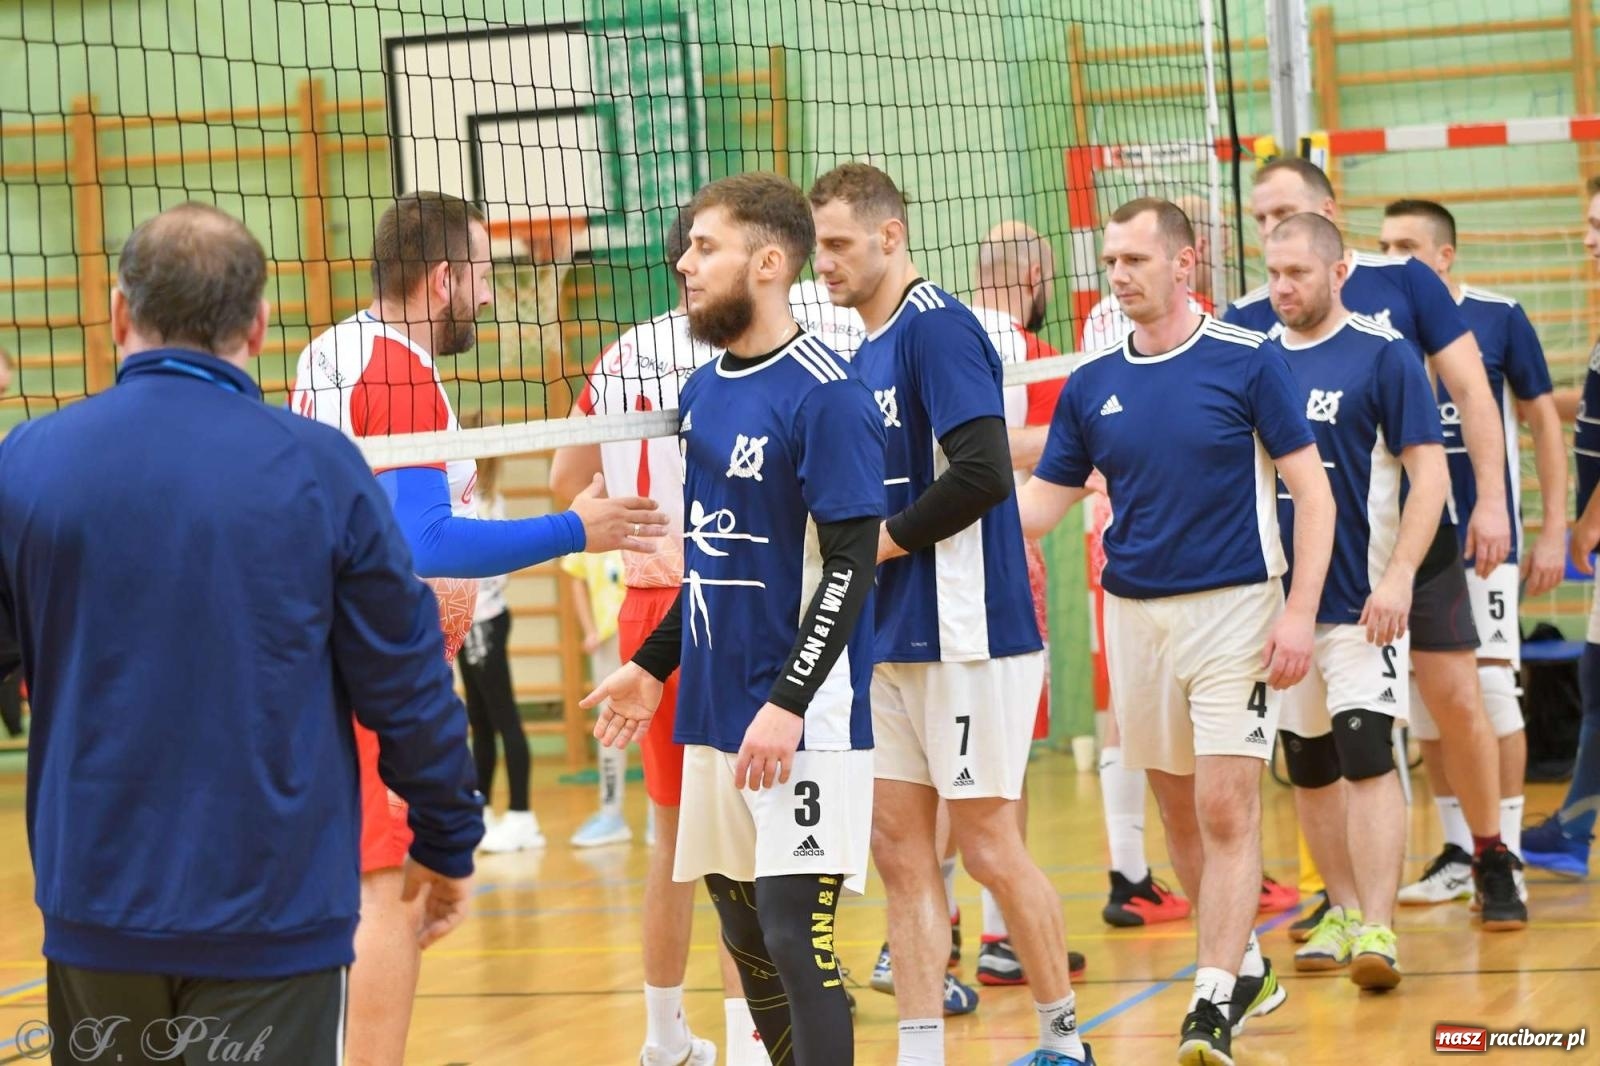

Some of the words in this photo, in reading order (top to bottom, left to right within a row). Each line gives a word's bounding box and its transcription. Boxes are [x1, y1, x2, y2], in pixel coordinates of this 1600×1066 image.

[819, 568, 853, 613] WILL
[1488, 590, 1505, 620] 5
[814, 623, 830, 639] &
[815, 614, 836, 627] I
[793, 635, 826, 677] CAN
[786, 674, 805, 686] I
[1247, 681, 1268, 719] 4
[955, 715, 970, 756] 7
[794, 780, 821, 827] 3
[793, 848, 825, 857] adidas
[818, 890, 834, 906] &
[811, 912, 837, 970] CAN
